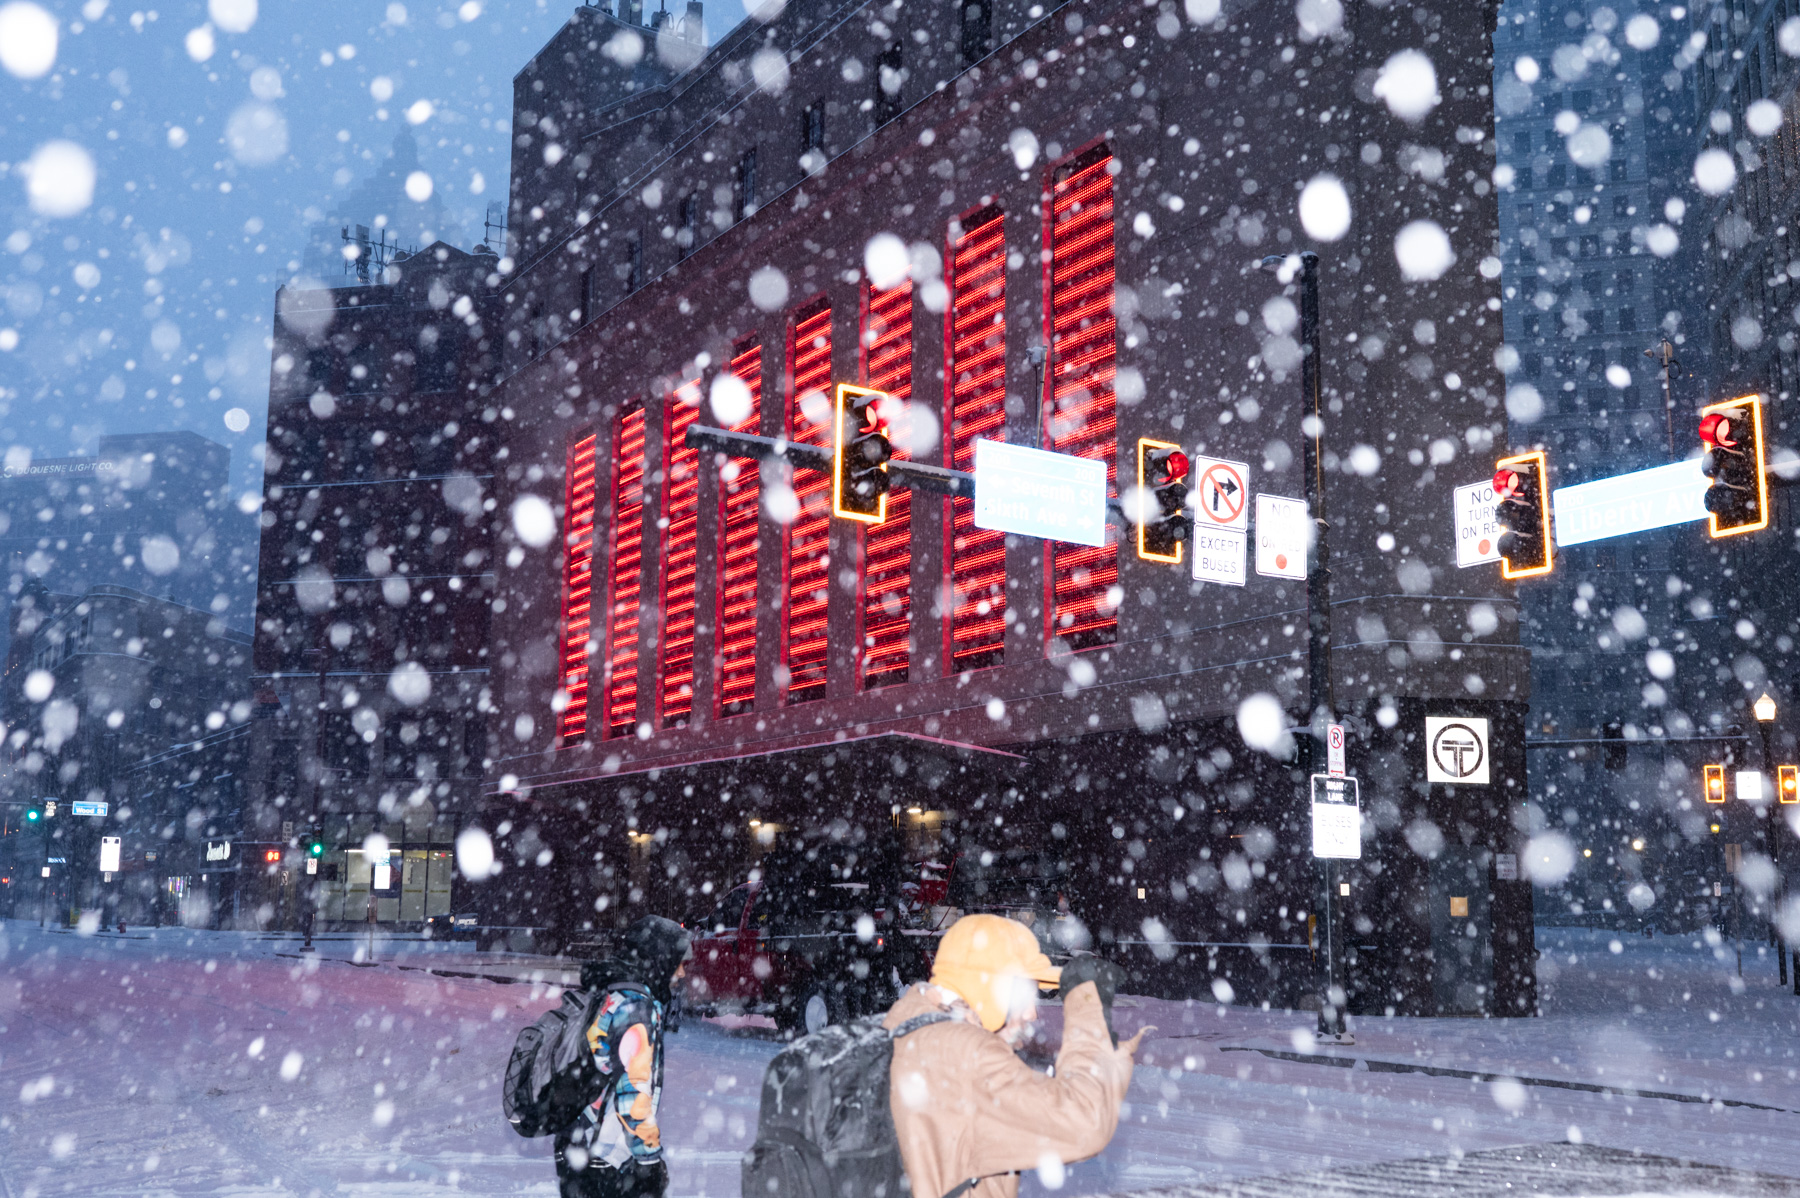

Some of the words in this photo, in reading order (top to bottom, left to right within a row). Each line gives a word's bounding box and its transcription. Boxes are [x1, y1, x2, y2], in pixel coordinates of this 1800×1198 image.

[16, 464, 67, 475] DUQUESNE
[69, 462, 97, 472] LIGHT
[98, 462, 114, 471] CO.
[1011, 476, 1075, 504] Seventh
[1079, 488, 1096, 507] St
[1471, 487, 1493, 505] NO
[985, 497, 1029, 521] Sixth
[1036, 507, 1068, 527] Ave
[1271, 502, 1292, 519] NO
[1568, 499, 1654, 535] Liberty
[1462, 525, 1477, 540] ON
[1483, 521, 1498, 535] RE
[1200, 536, 1240, 553] EXCEPT
[1202, 557, 1237, 574] BUSES
[1327, 791, 1345, 802] LANE
